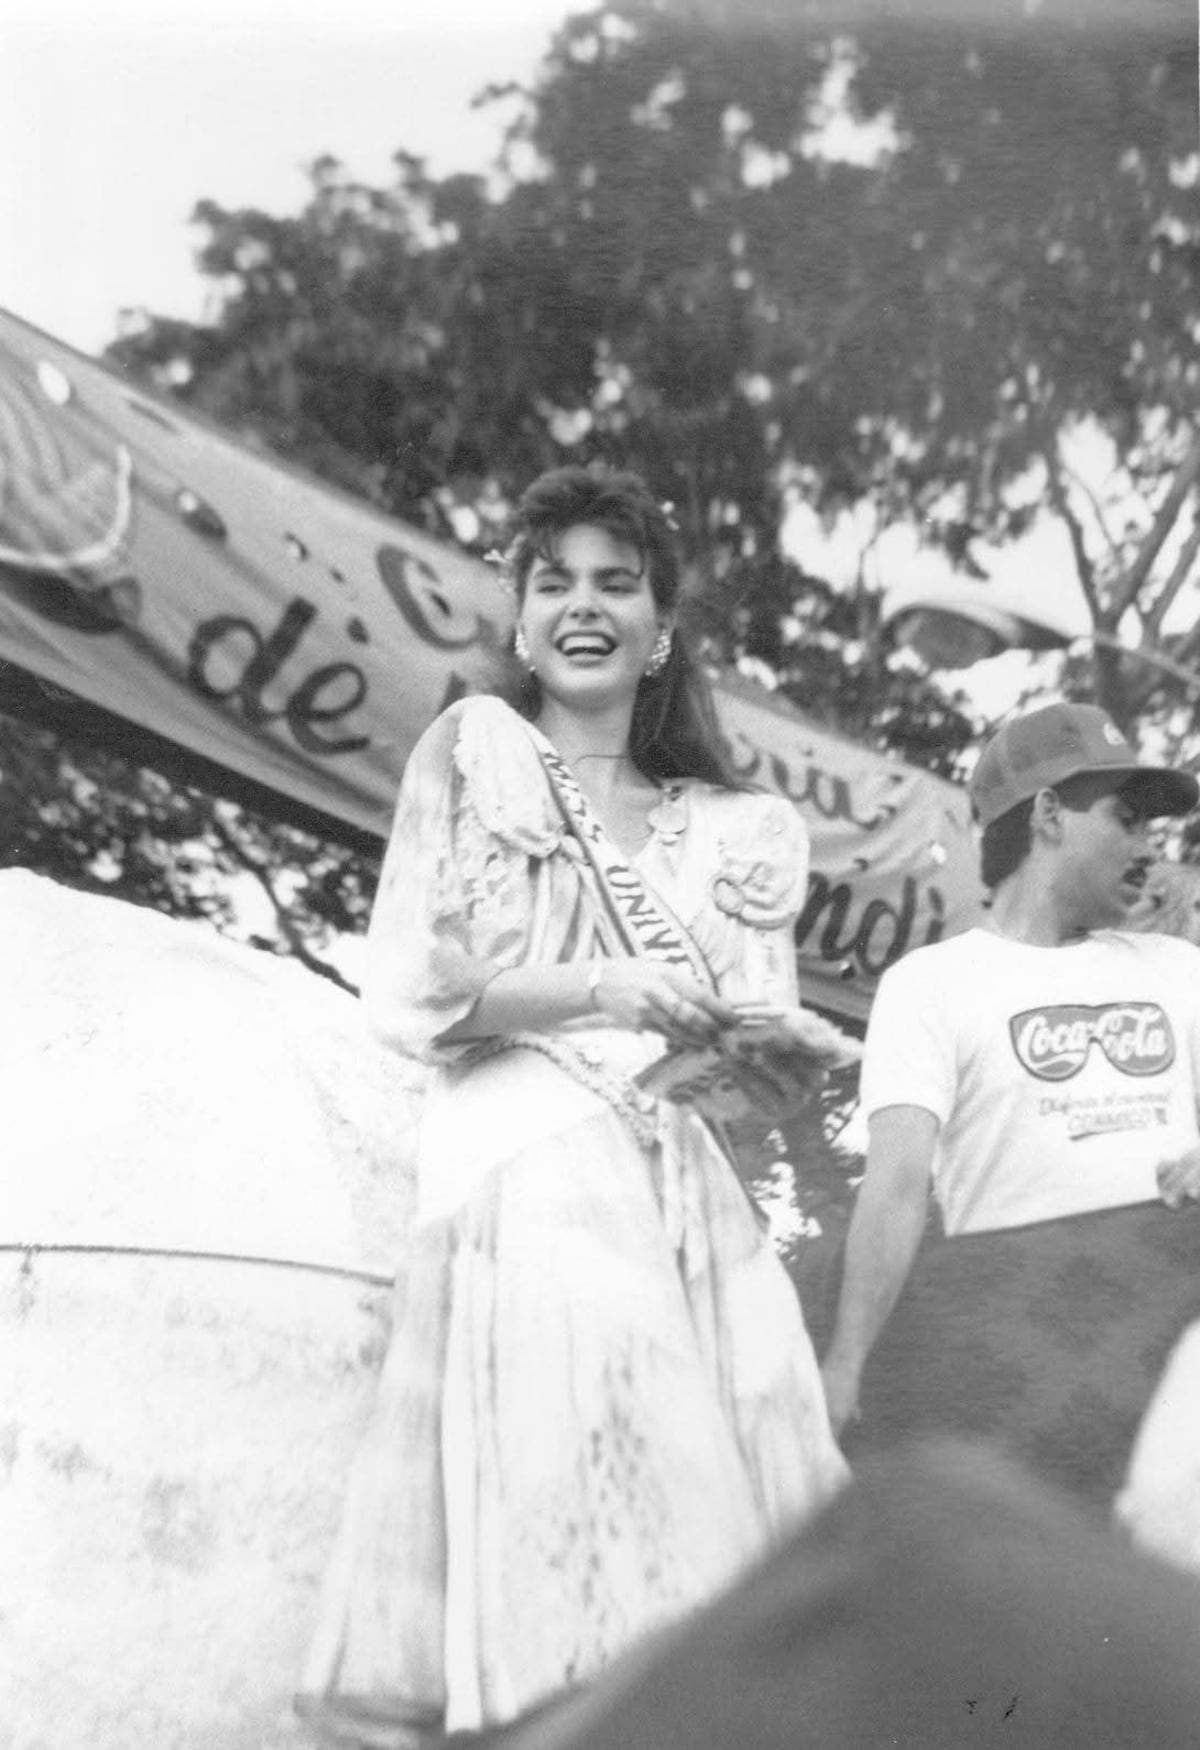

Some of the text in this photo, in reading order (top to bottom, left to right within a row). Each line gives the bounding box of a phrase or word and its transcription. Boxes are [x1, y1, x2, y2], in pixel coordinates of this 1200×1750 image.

[189, 596, 371, 755] de
[541, 751, 603, 844] MISS
[1018, 1006, 1168, 1067] Coca-Cola
